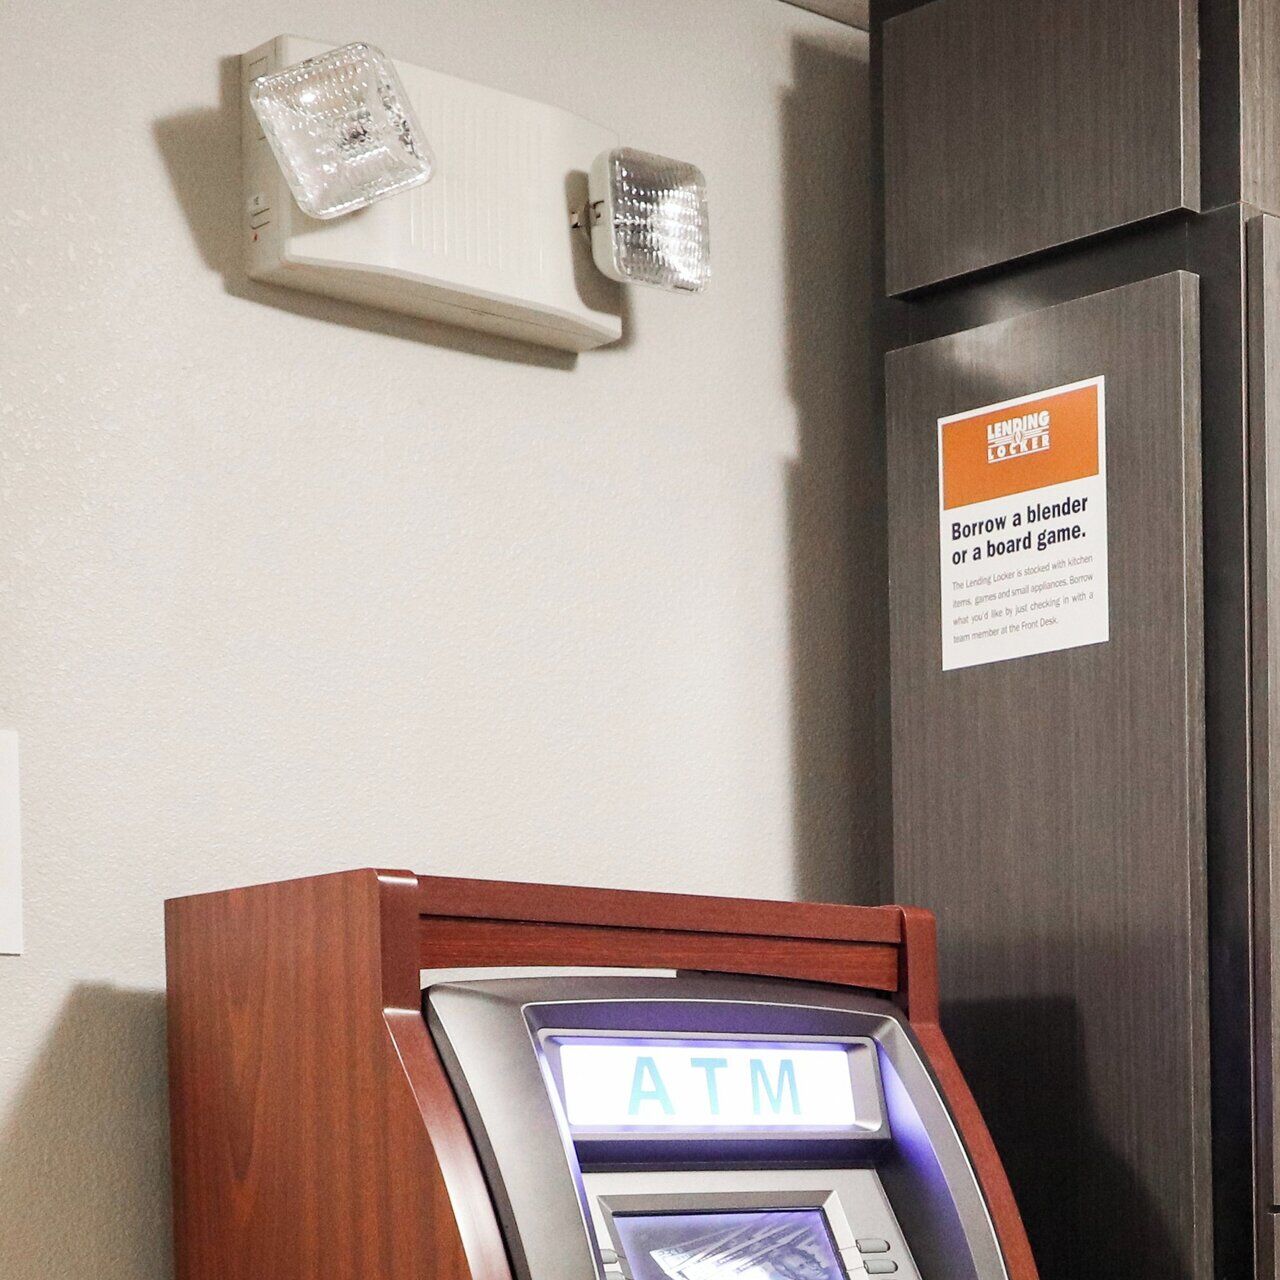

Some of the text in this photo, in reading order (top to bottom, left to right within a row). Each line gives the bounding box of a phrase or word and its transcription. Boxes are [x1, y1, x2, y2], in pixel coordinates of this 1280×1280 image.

[987, 410, 1050, 441] LENDING
[987, 434, 1050, 461] LOCKER
[952, 496, 1088, 541] Borrow a blender
[952, 524, 1086, 566] or a board game.
[627, 1056, 802, 1115] ATM
